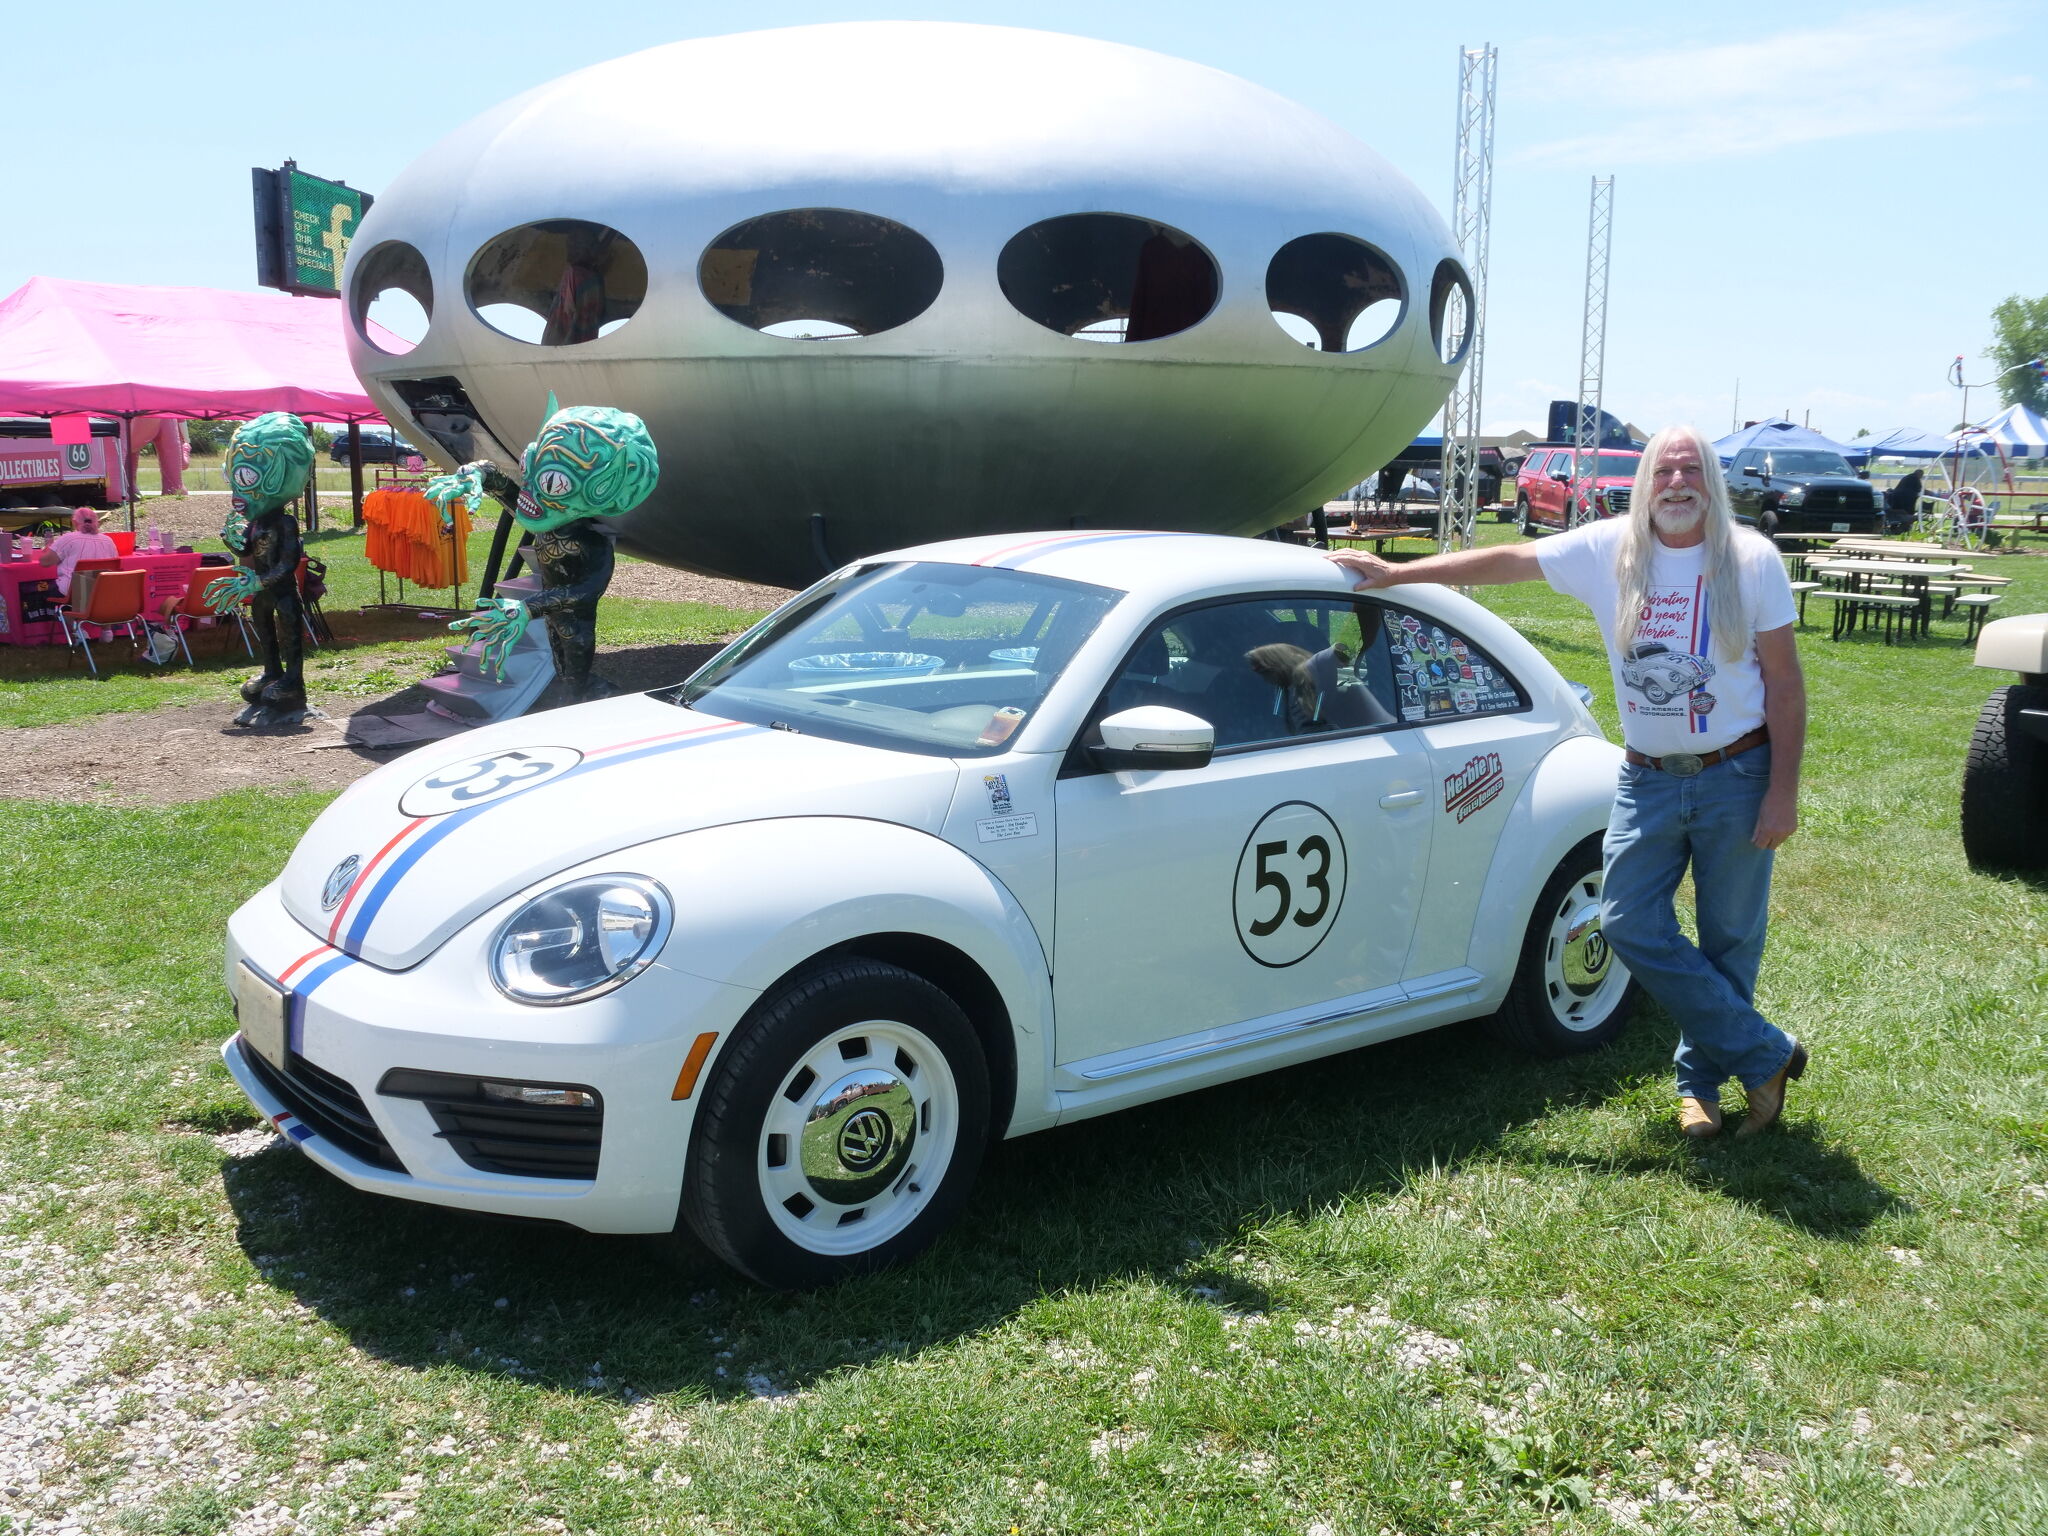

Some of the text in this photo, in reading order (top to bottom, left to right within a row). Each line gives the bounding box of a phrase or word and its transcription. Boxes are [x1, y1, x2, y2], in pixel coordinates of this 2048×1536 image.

[294, 210, 320, 224] CHECK
[294, 221, 310, 233] OUT
[295, 233, 312, 245] OUR
[296, 245, 327, 259] WEEKLY
[298, 257, 334, 272] SPECIALS
[72, 445, 86, 462] 66
[1655, 611, 1688, 624] years
[425, 752, 554, 801] 53
[1445, 757, 1488, 802] Herbie
[1249, 834, 1331, 937] 53
